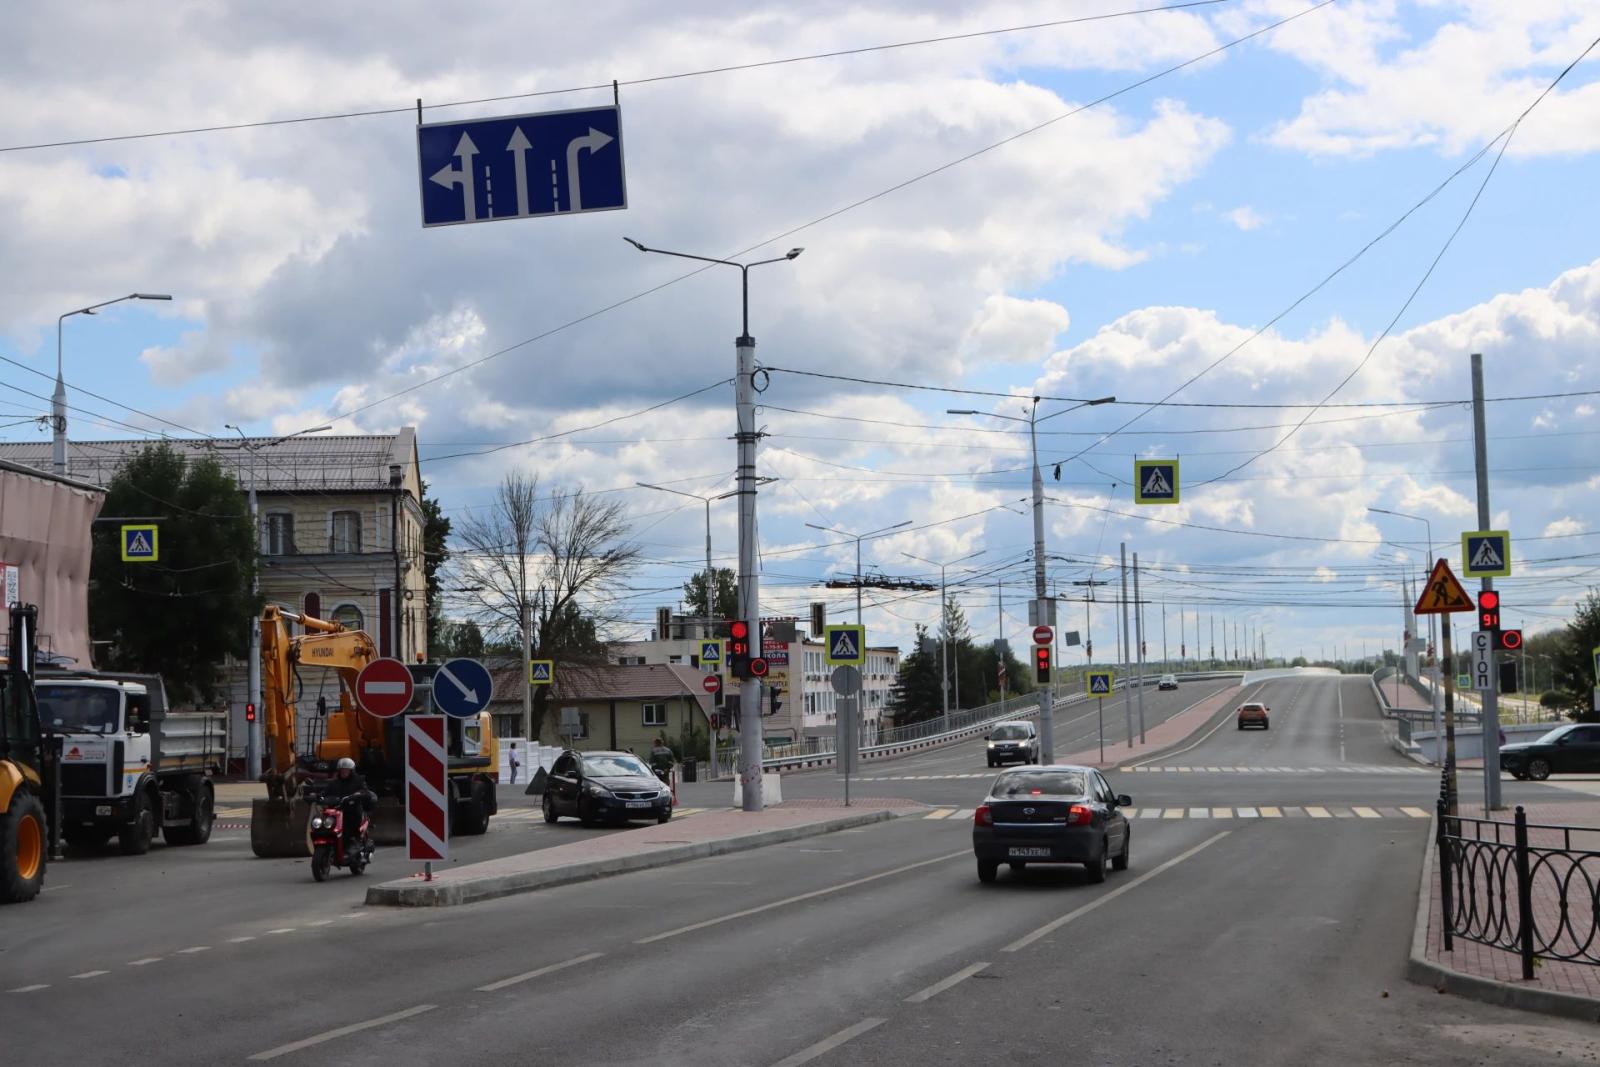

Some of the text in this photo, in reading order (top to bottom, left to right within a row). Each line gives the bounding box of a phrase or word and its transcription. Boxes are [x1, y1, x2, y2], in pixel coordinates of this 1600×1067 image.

[1483, 614, 1497, 626] 91
[312, 648, 334, 657] HYUNDAI
[735, 643, 747, 654] 91
[1476, 634, 1488, 687] СТОП
